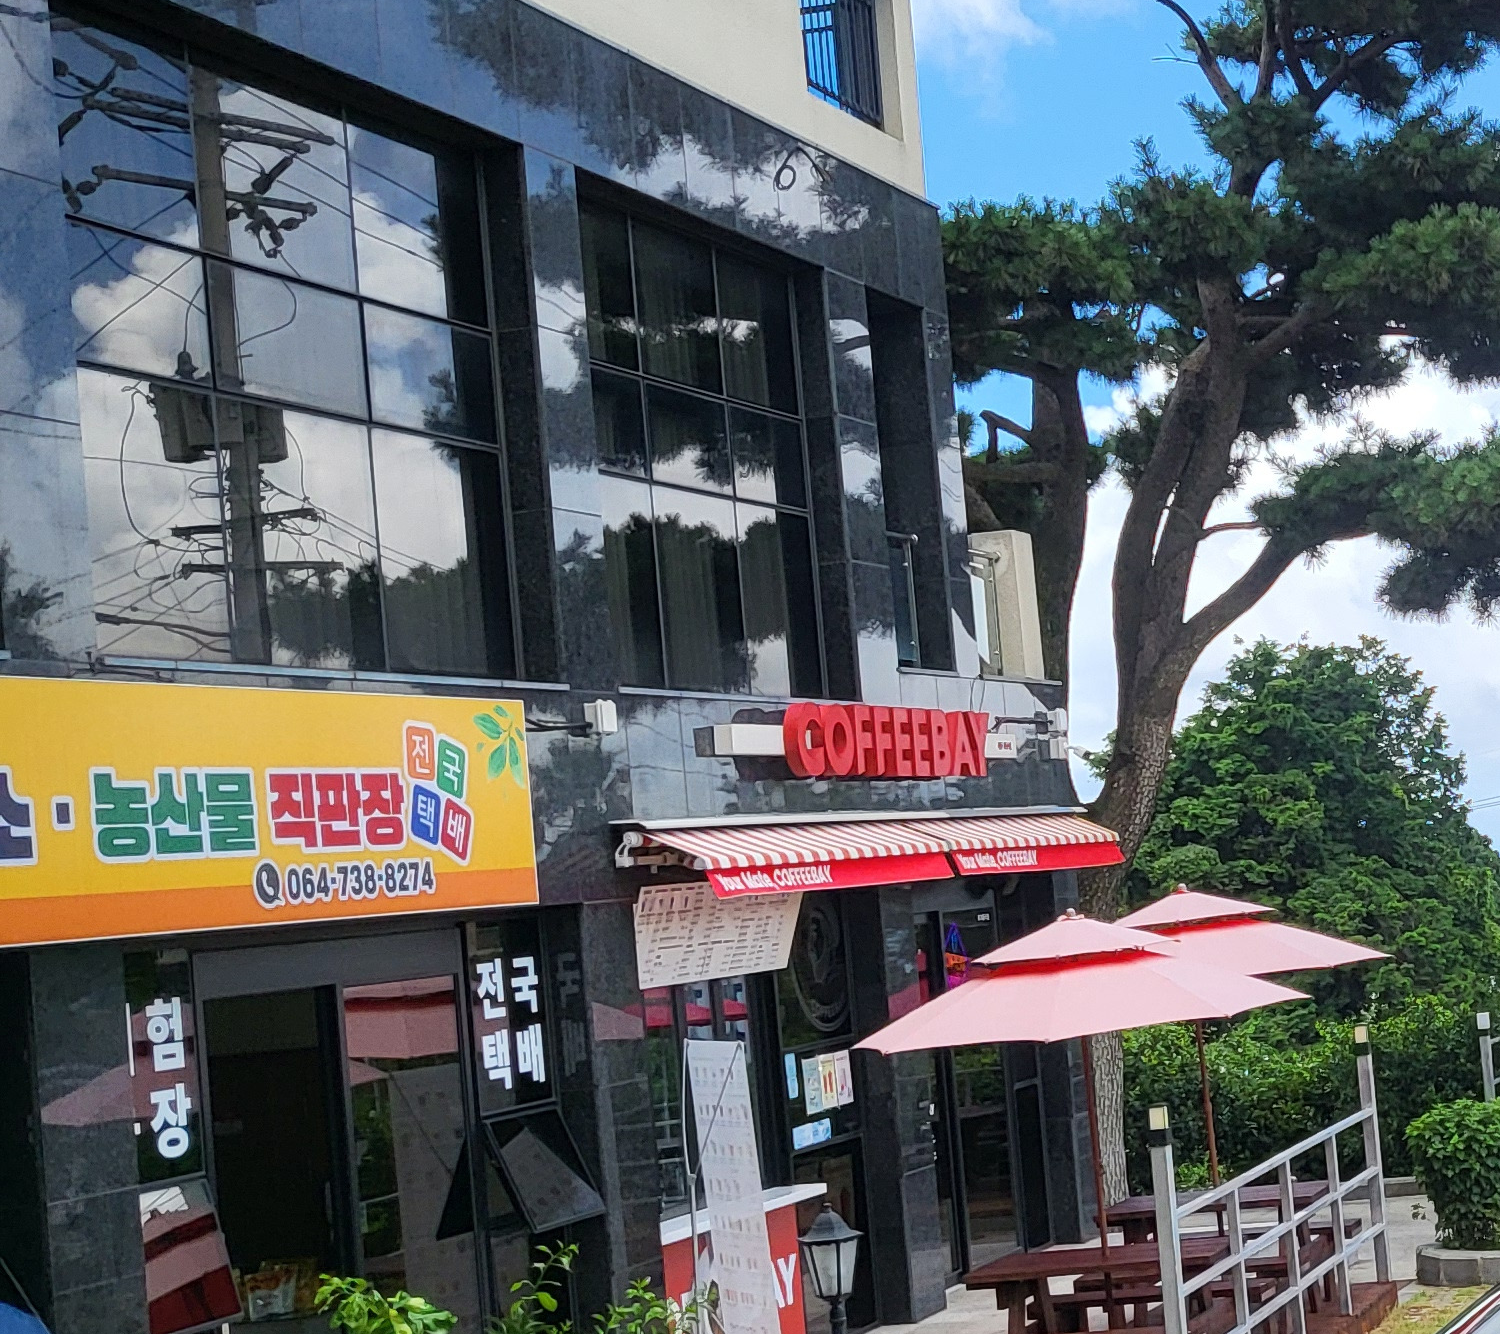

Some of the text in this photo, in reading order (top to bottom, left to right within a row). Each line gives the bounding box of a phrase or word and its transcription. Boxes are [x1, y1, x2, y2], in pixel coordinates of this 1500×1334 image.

[411, 734, 459, 793] 전국
[783, 702, 989, 777] COFFEEBAY
[93, 773, 256, 856] 농산물
[269, 773, 404, 848] 직판장
[417, 793, 467, 854] 택배
[287, 860, 434, 900] 064-738-8274
[714, 873, 746, 892] Your
[773, 865, 834, 887] COFFEEBAY
[997, 850, 1038, 867] COFFEEBAY
[476, 956, 539, 1020] 전국
[481, 1023, 546, 1090] 택배
